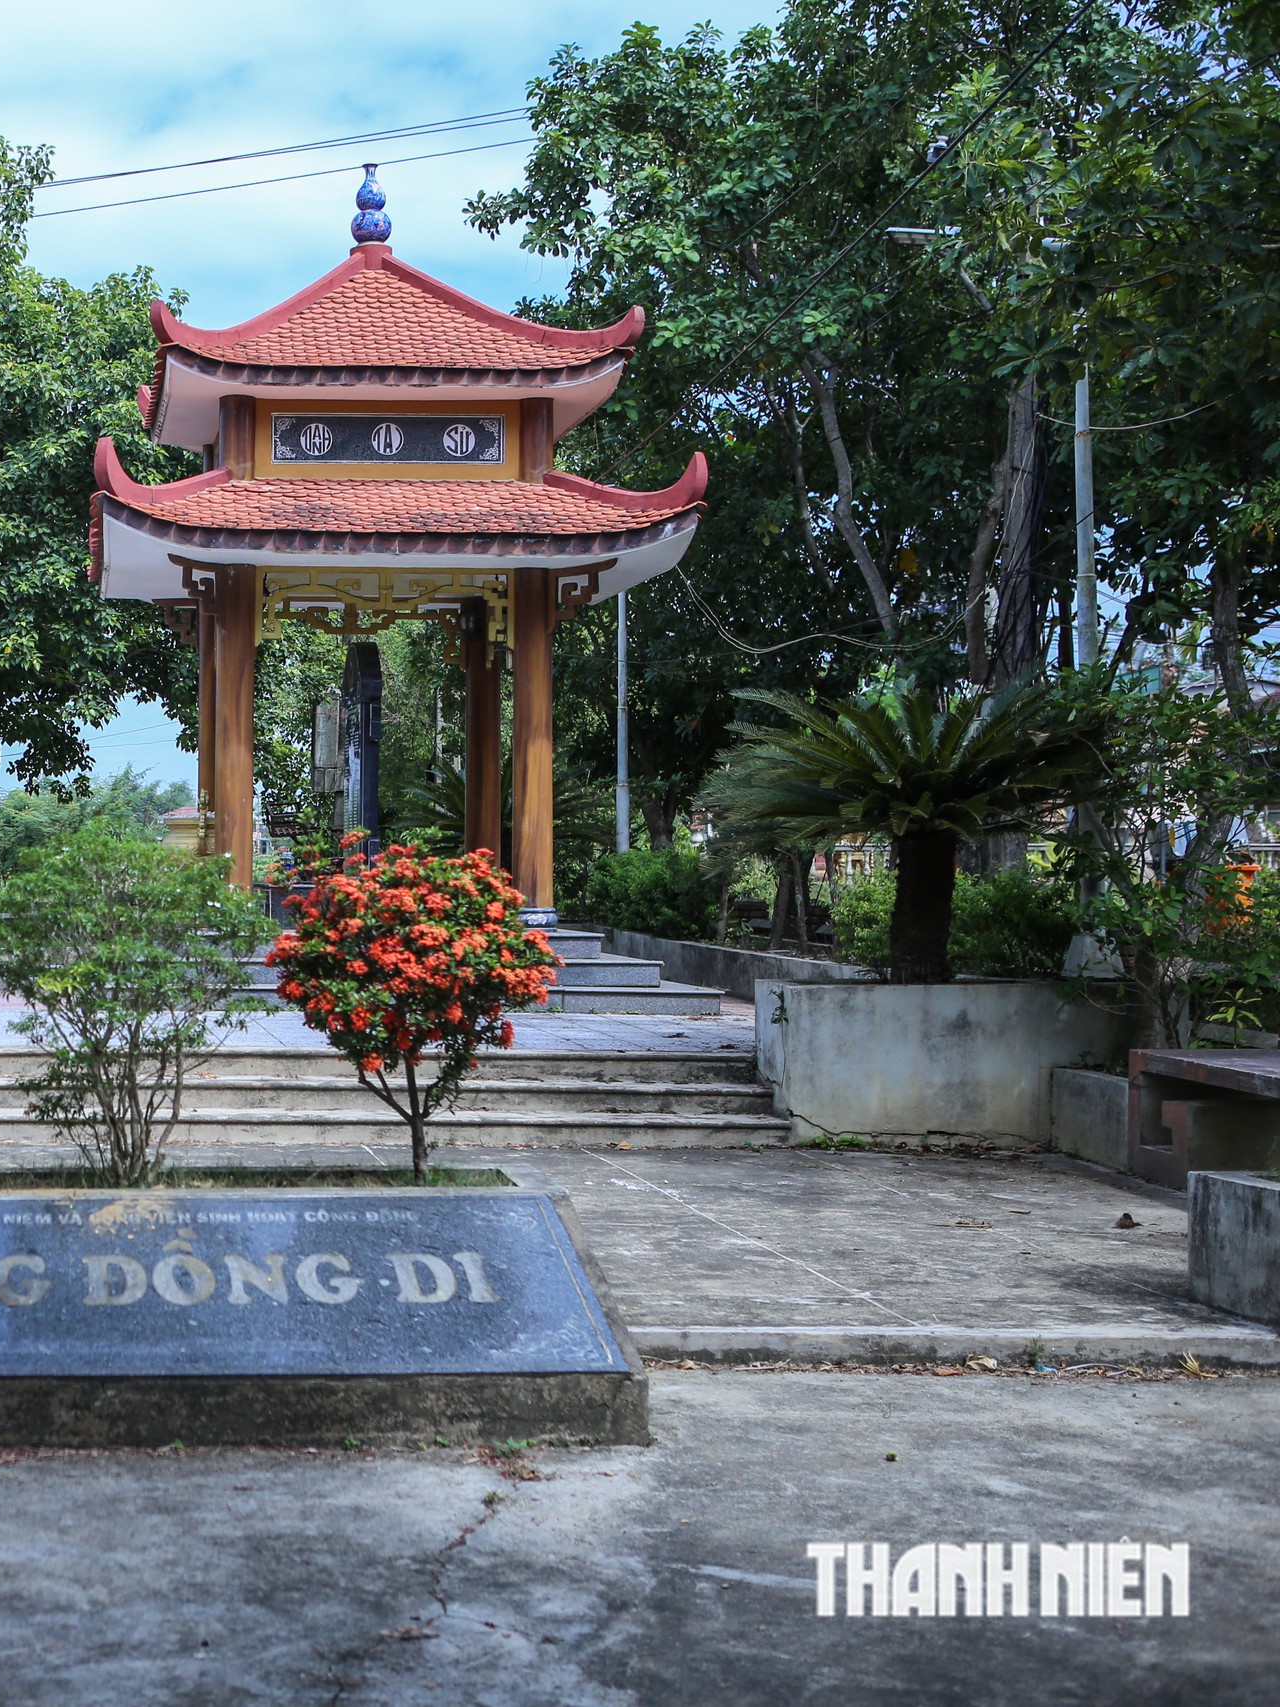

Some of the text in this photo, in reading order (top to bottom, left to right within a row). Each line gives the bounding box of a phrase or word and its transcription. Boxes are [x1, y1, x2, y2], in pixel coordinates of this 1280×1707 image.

[196, 1210, 241, 1224] SINH
[81, 1227, 364, 1306] ĐỒNG
[385, 1250, 502, 1305] DI
